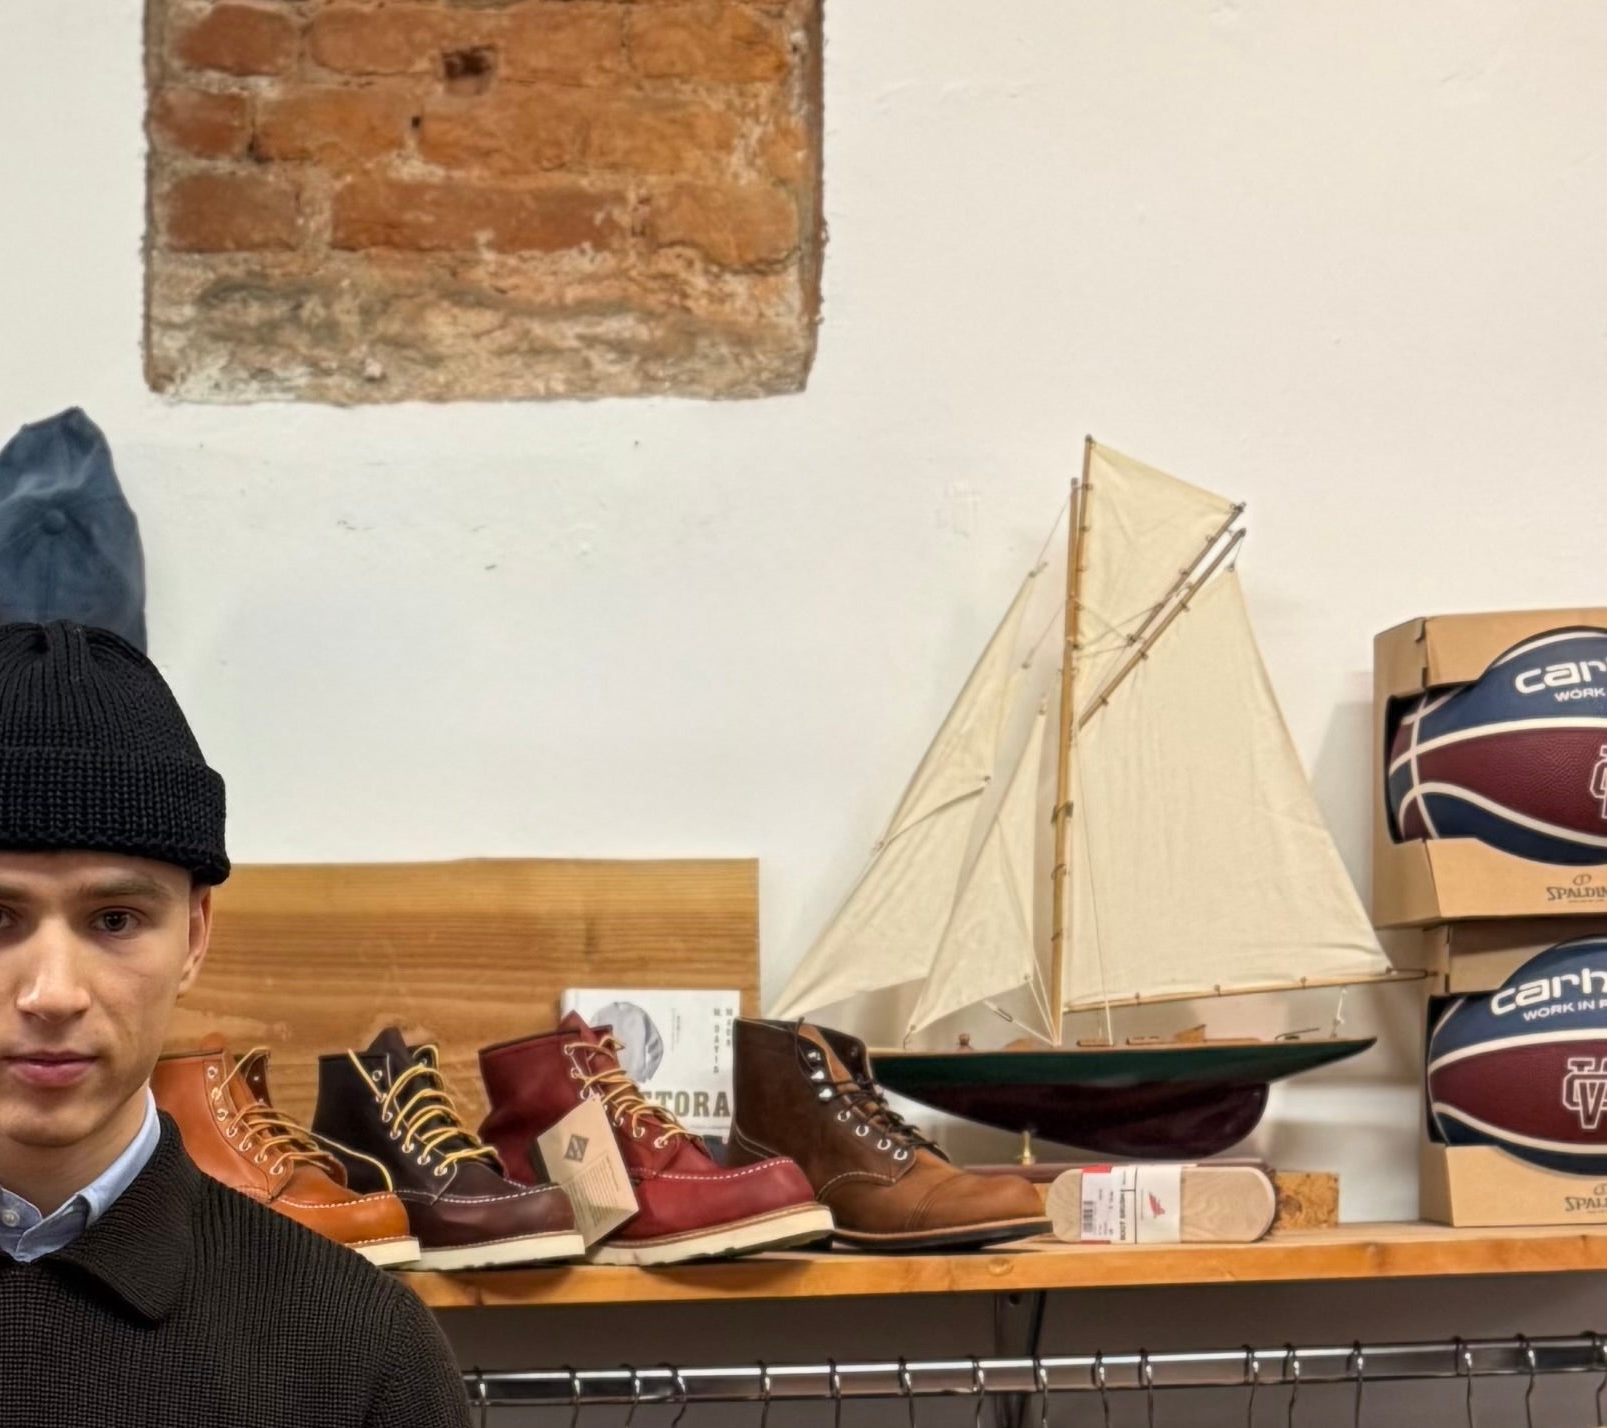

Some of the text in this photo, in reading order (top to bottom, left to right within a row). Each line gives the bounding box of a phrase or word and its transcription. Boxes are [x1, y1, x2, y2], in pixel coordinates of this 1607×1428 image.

[1515, 659, 1607, 694] car
[1554, 687, 1606, 702] WORK
[1523, 1001, 1575, 1021] WORK
[1577, 999, 1595, 1011] IN
[640, 1091, 731, 1117] TORA
